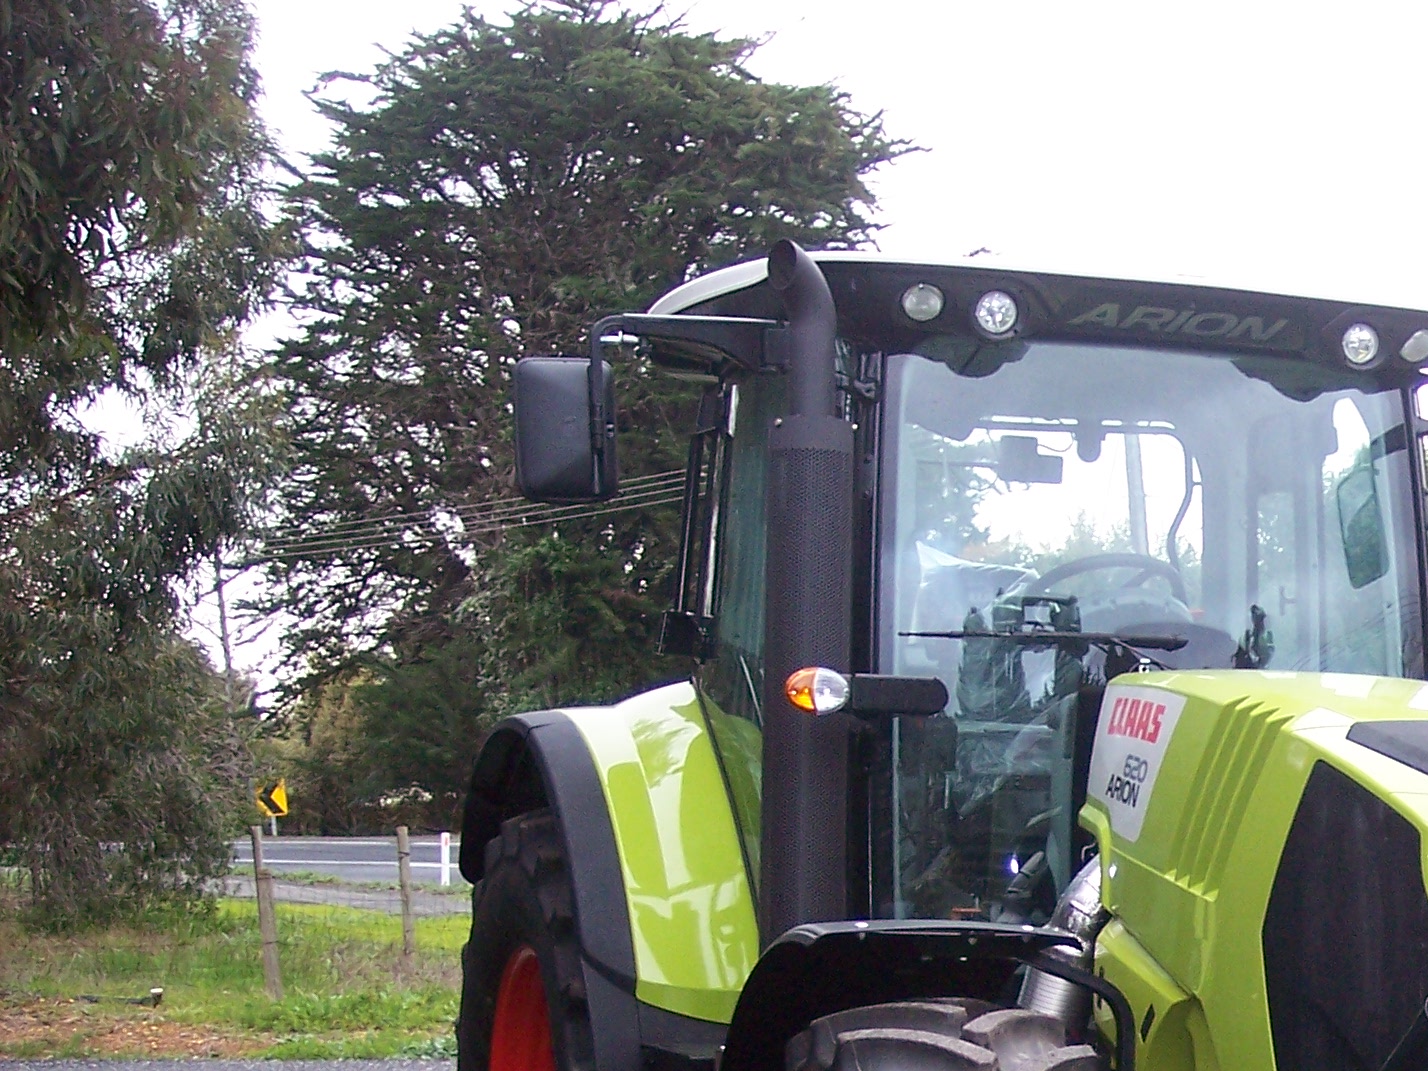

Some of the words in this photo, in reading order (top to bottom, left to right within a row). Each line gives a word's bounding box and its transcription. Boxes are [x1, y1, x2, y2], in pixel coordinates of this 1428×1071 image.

[1066, 302, 1288, 341] ARION
[1107, 697, 1167, 744] CLAAS
[1105, 774, 1140, 807] ARION
